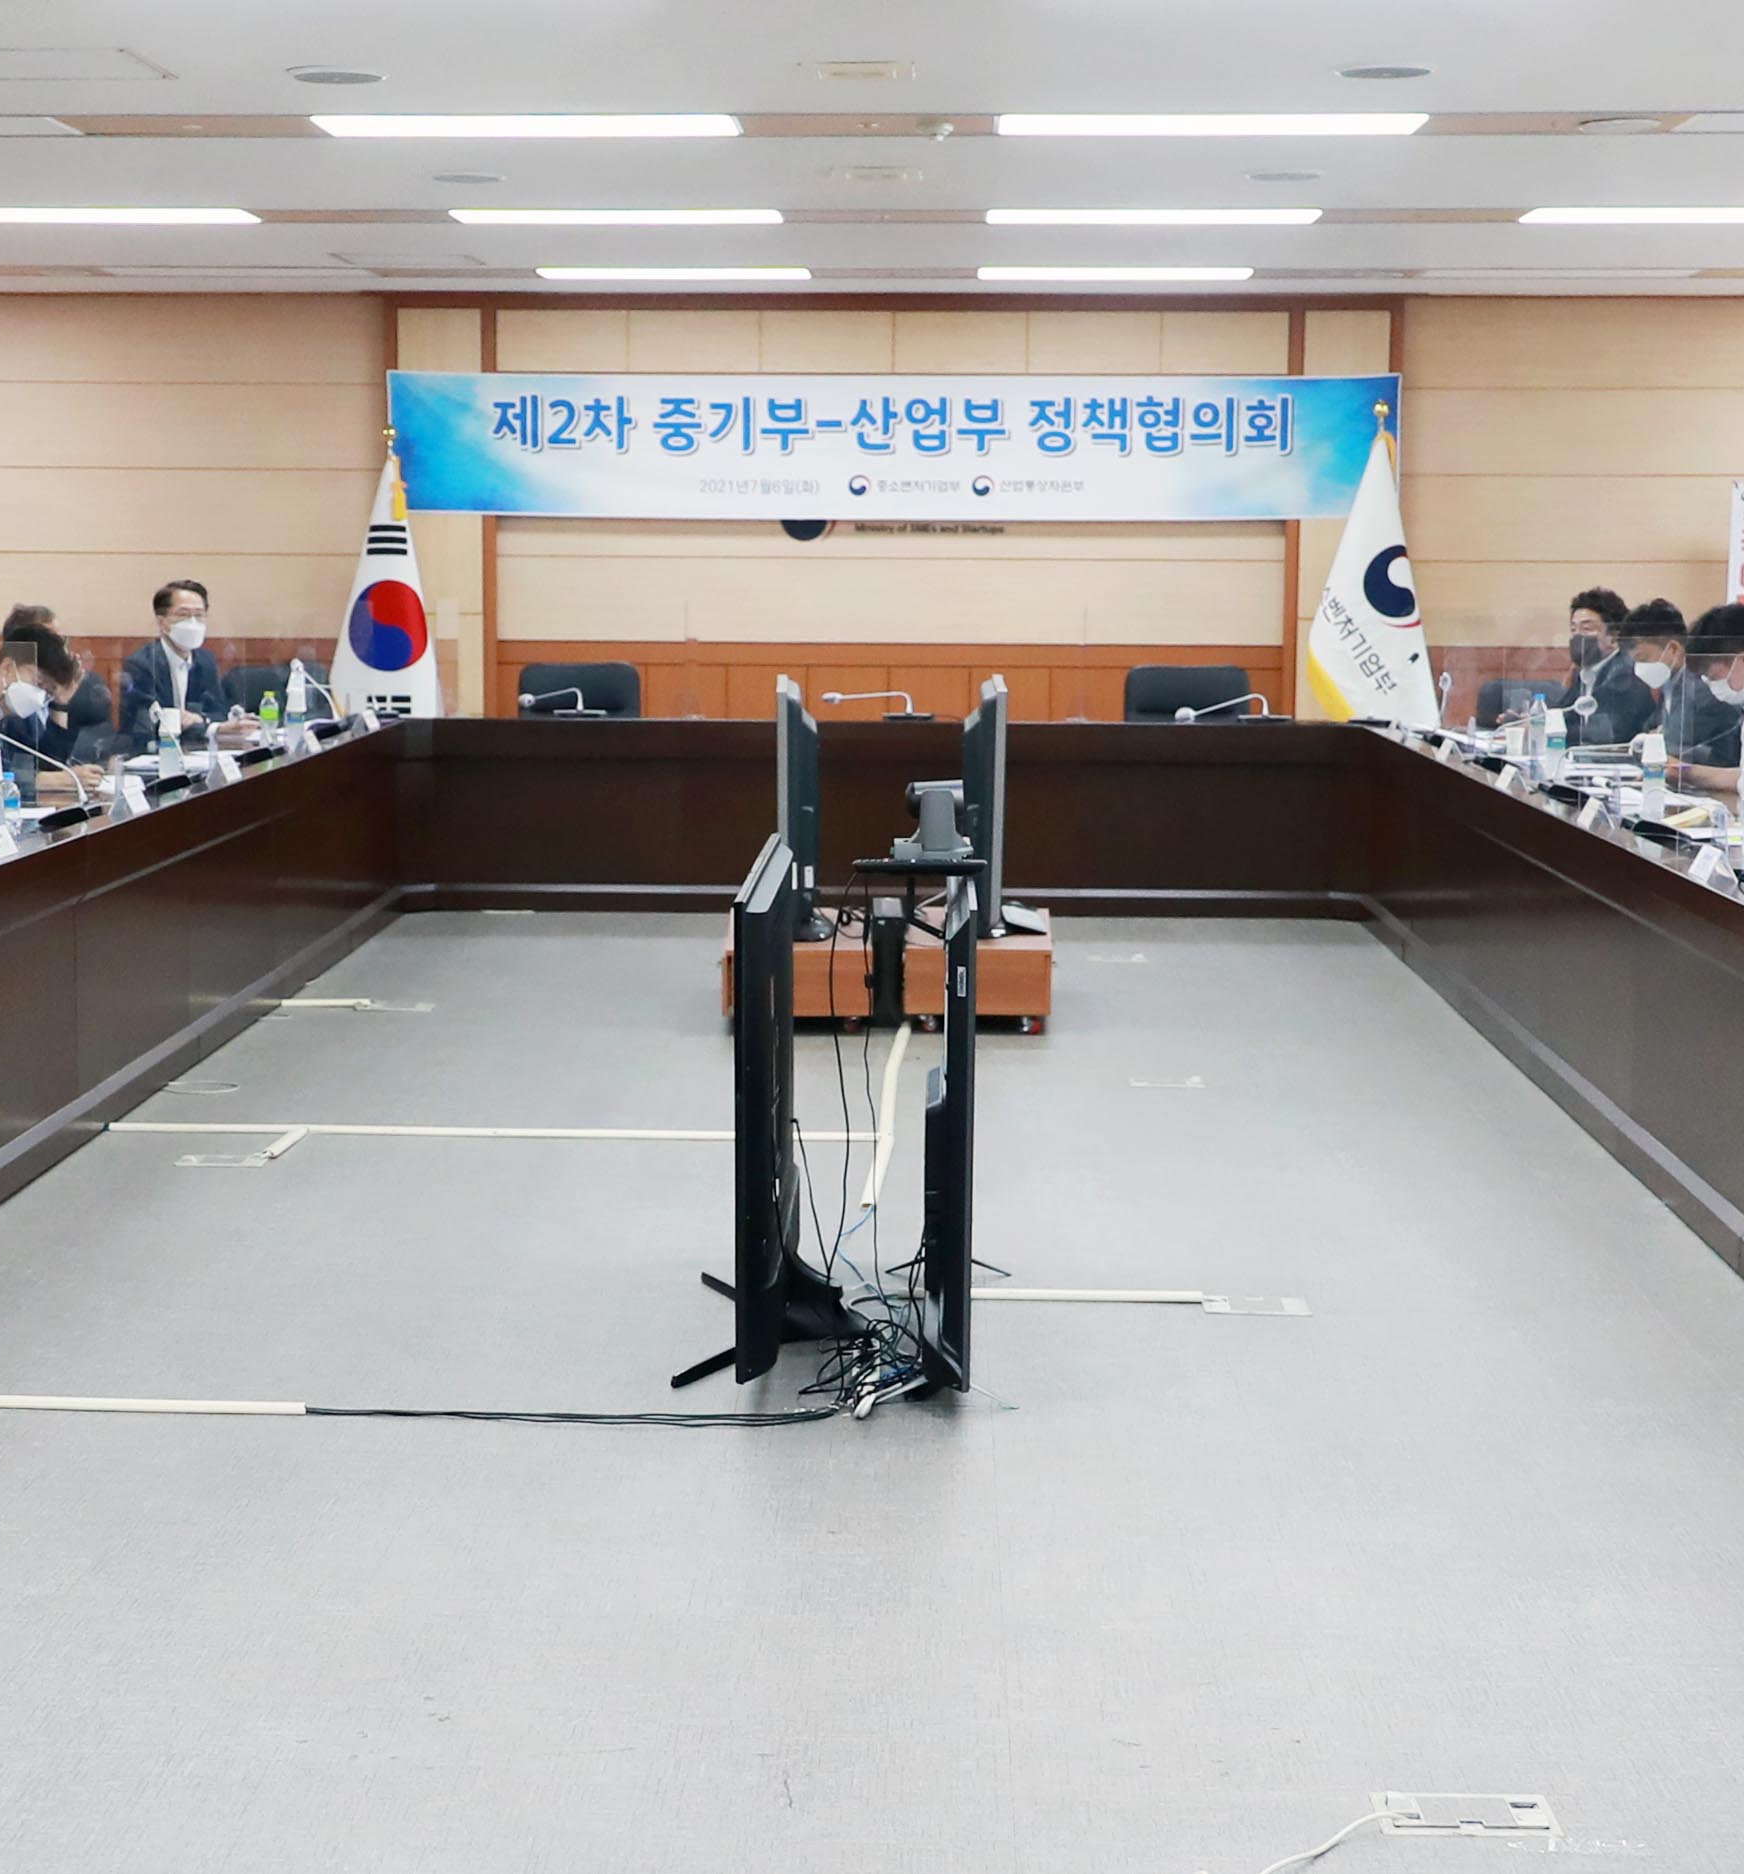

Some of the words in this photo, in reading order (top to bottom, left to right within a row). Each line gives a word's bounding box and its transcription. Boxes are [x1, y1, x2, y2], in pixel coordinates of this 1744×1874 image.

[491, 394, 635, 452] 제2차
[655, 395, 1010, 454] 중기부-산업부
[1028, 394, 1293, 455] 정책협의회
